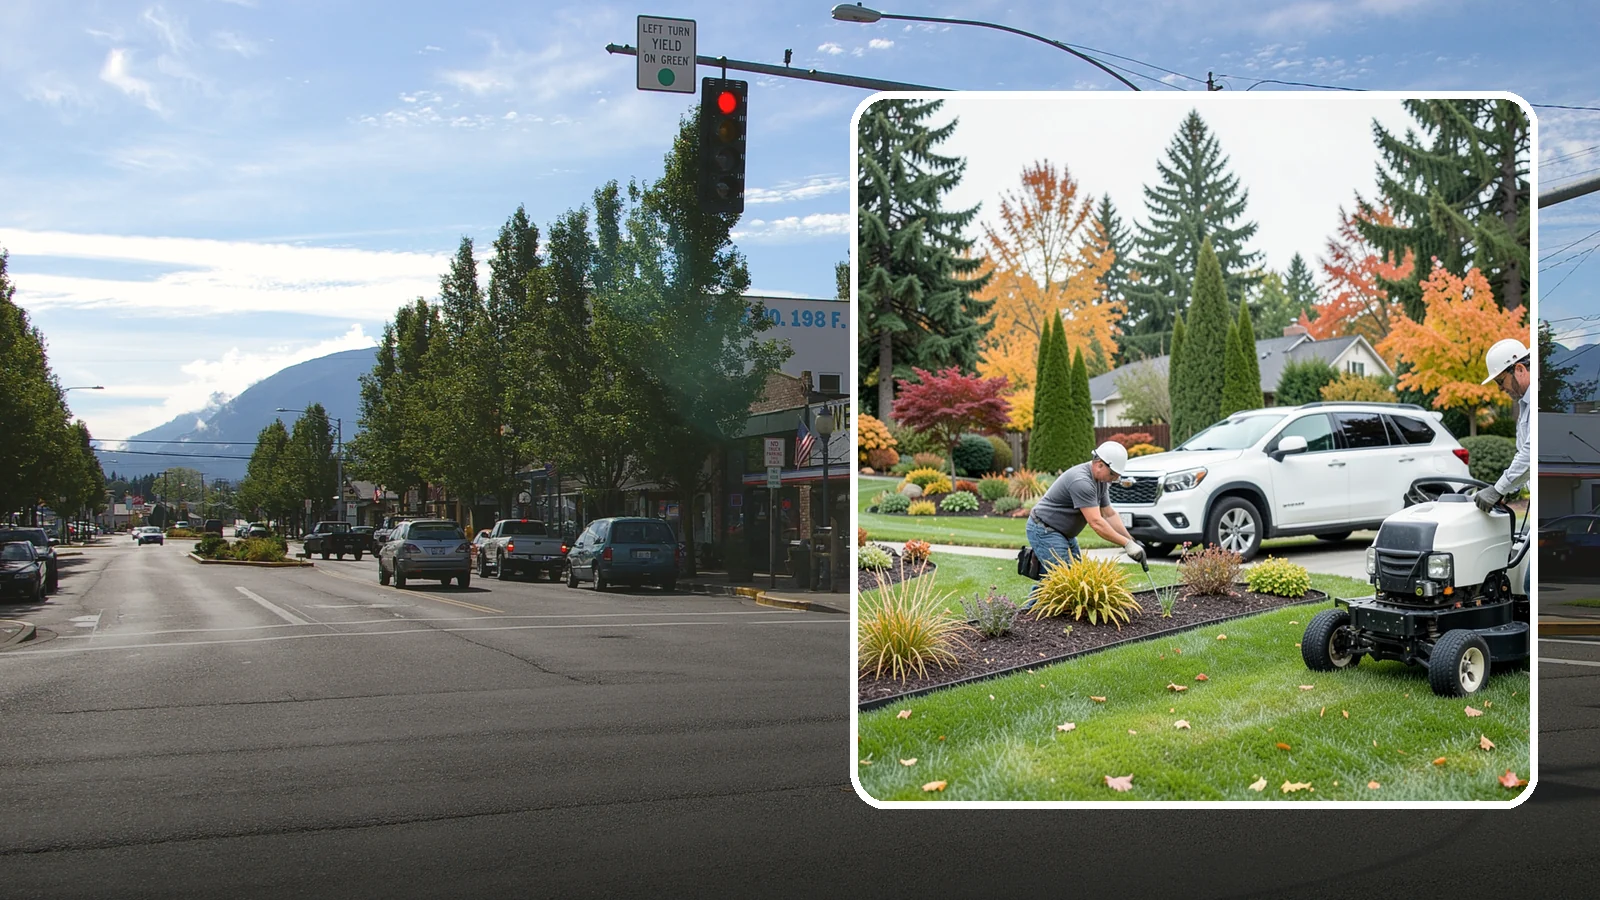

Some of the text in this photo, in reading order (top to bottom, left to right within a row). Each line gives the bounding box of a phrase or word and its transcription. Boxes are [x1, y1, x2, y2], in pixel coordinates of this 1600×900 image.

[643, 23, 690, 37] LEFT TURN
[652, 38, 682, 52] YIELD
[644, 53, 688, 66] ON GREEN
[791, 309, 826, 328] 198
